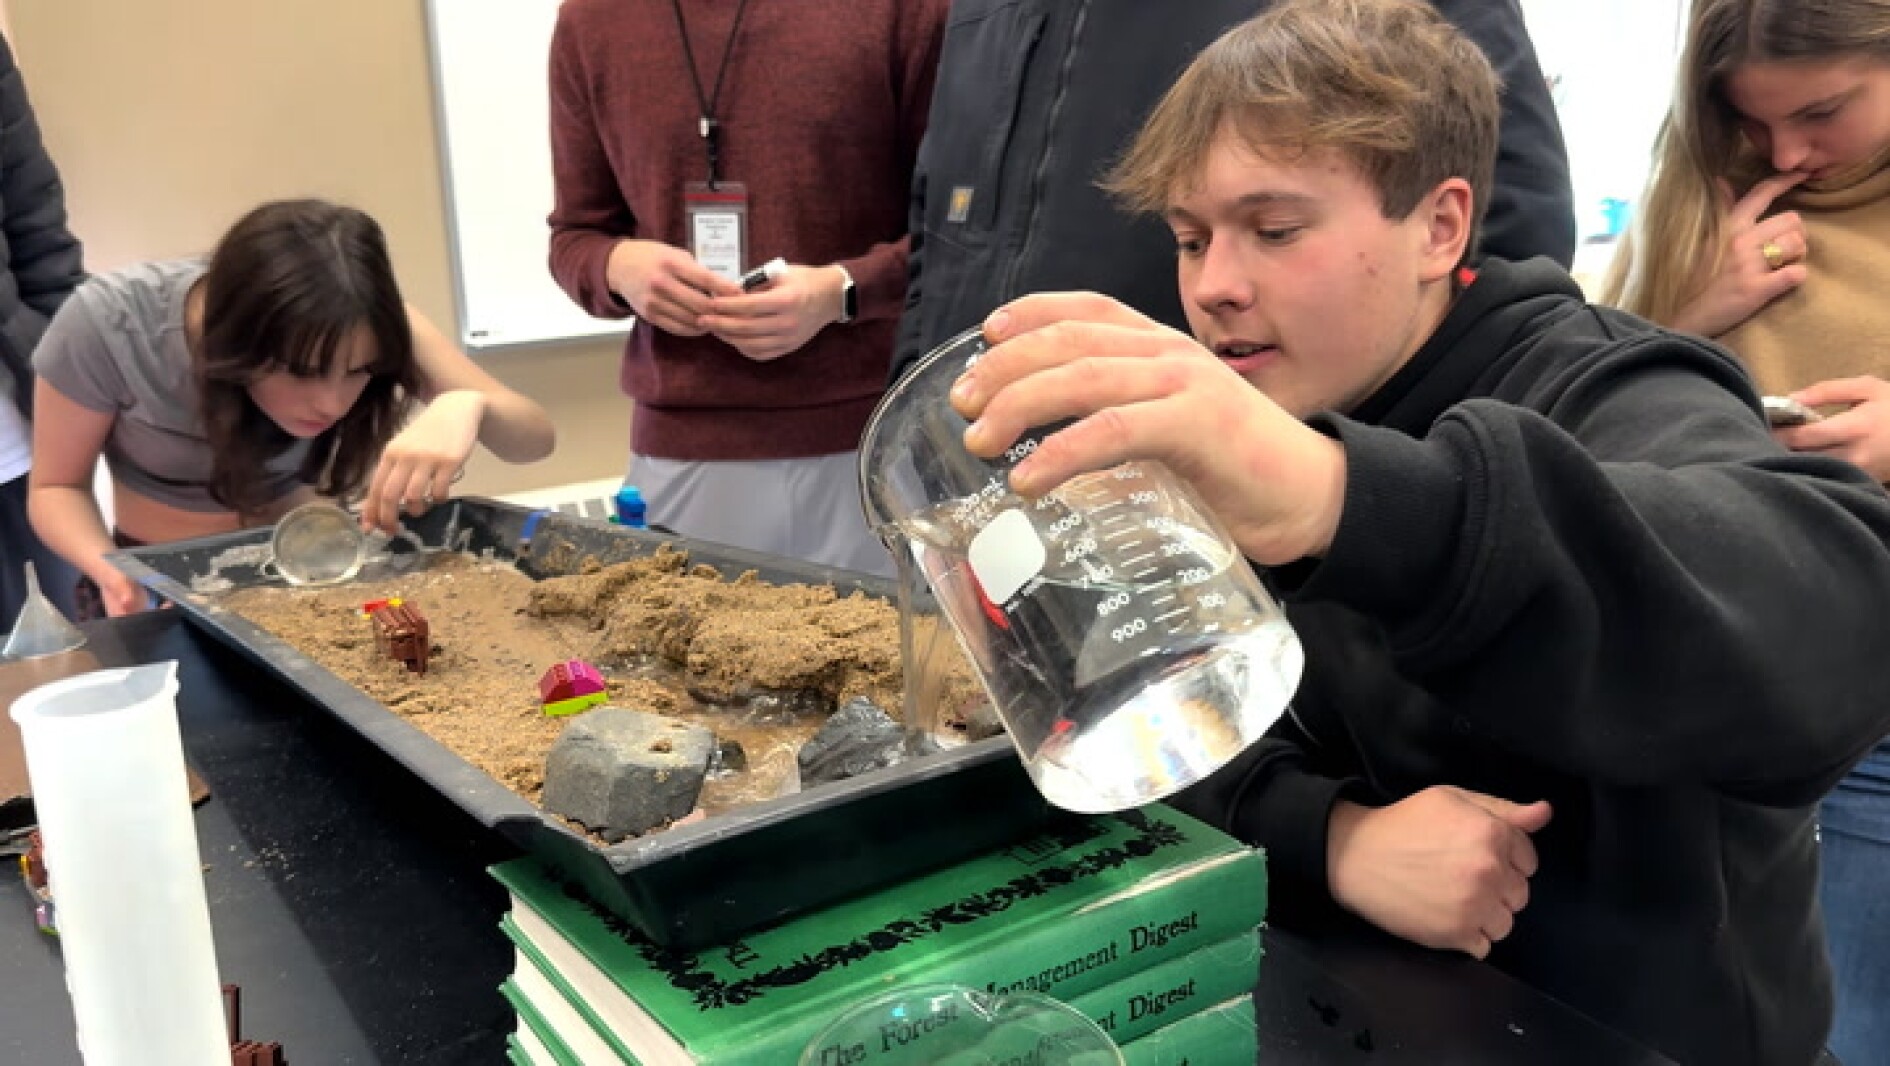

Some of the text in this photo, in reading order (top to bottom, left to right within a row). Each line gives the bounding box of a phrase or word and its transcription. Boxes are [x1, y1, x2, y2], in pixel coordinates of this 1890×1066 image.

[1175, 566, 1211, 584] 200
[1097, 592, 1131, 617] 800
[1111, 616, 1147, 643] 900
[878, 1003, 959, 1051] Forest
[1129, 910, 1199, 955] Digest
[1128, 977, 1197, 1023] Digest
